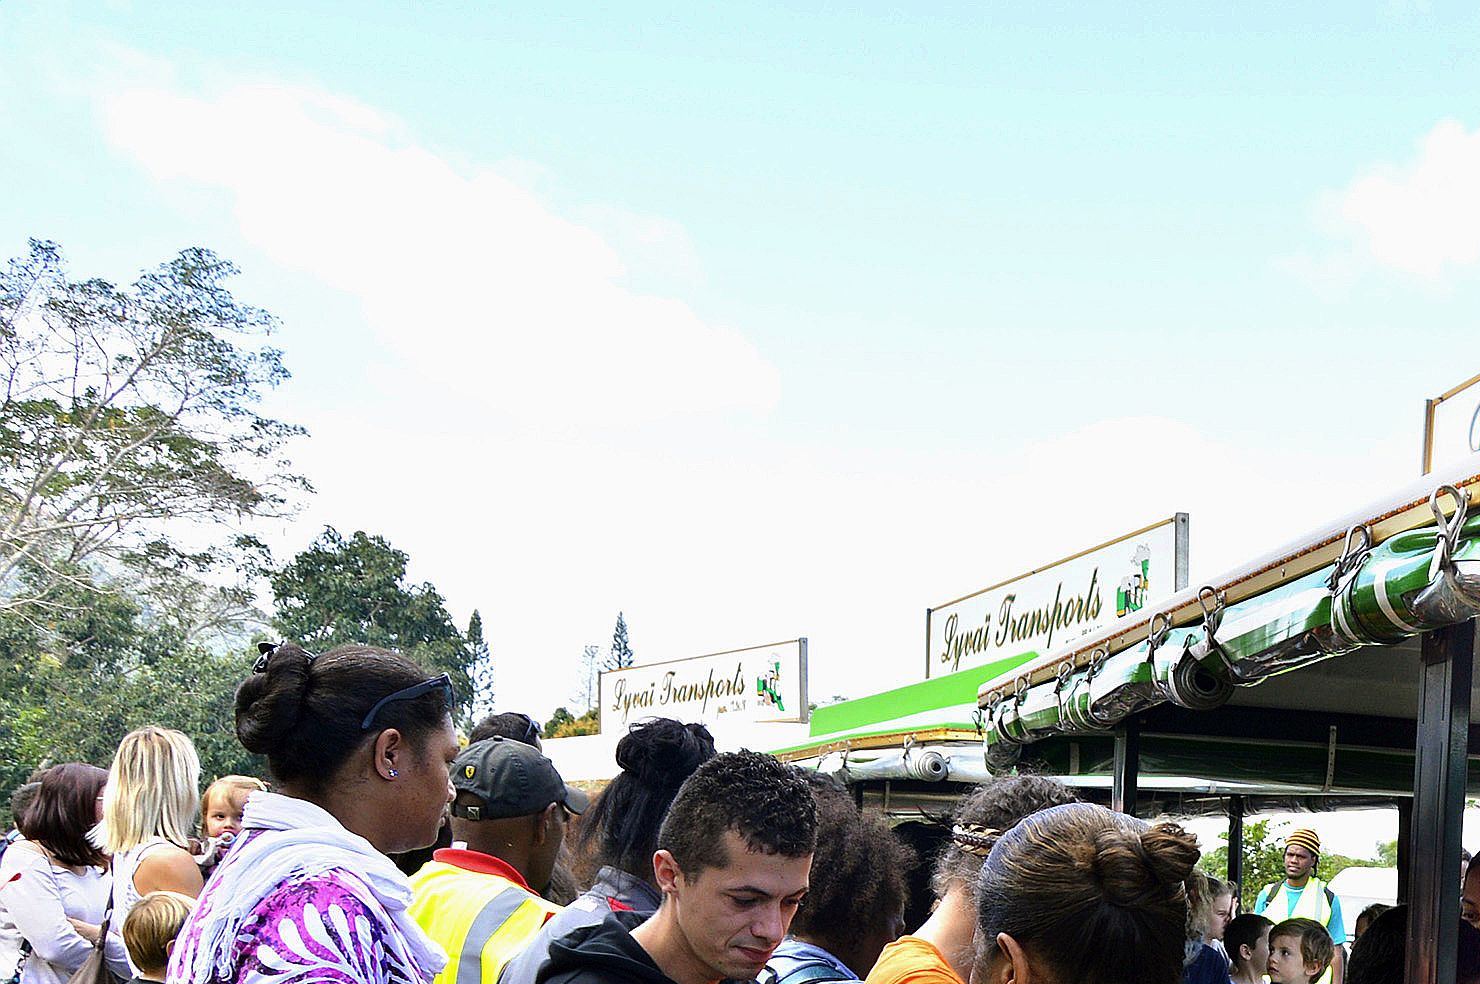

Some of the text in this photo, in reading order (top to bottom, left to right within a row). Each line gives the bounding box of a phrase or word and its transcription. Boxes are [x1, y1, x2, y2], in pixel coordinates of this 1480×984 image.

[941, 566, 1103, 671] Lyvaï Transports
[660, 662, 746, 714] Transports
